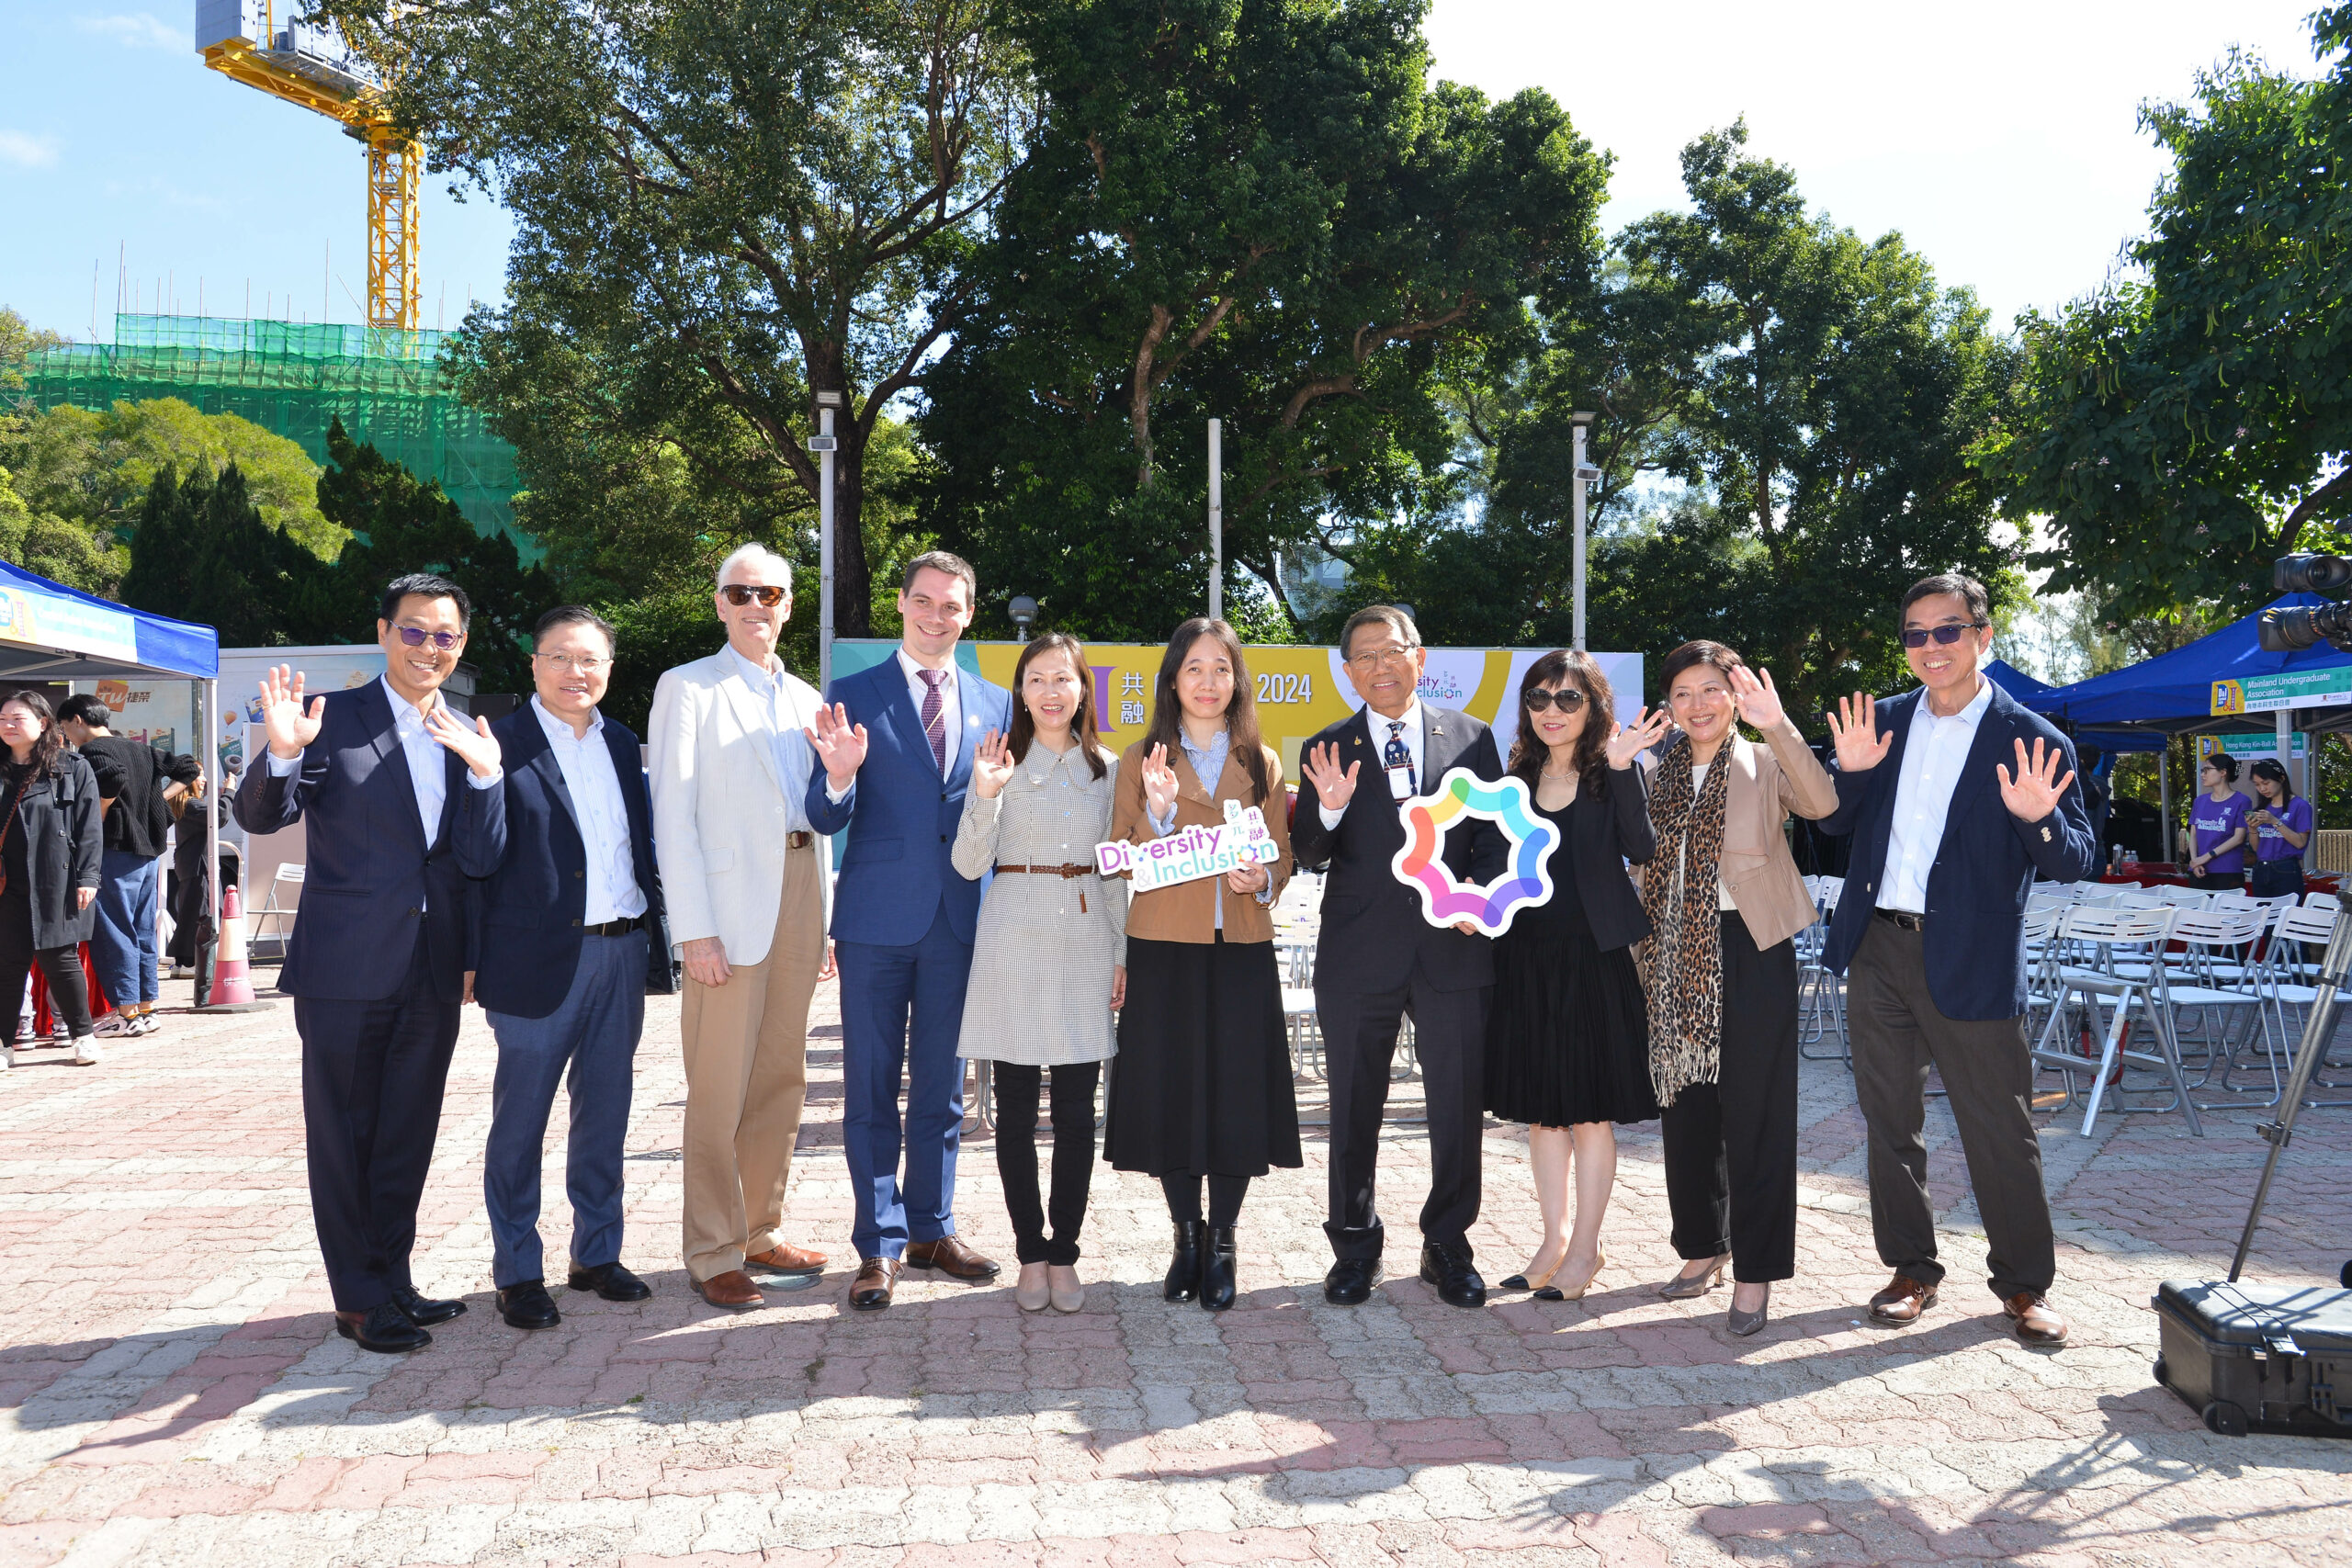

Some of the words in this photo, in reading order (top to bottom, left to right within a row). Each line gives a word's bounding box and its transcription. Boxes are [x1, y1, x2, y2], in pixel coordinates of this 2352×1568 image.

[1257, 673, 1313, 704] 2024
[1417, 686, 1463, 699] clusion
[2246, 688, 2285, 699] Association
[2247, 678, 2278, 689] Mainland
[2278, 672, 2331, 686] Undergraduate
[1121, 671, 1145, 725] 共融
[2225, 741, 2239, 750] Hong
[2239, 740, 2252, 750] Kong
[1248, 810, 1265, 841] 共融
[1100, 829, 1222, 871] Diversity
[1152, 841, 1276, 884] Inclusion
